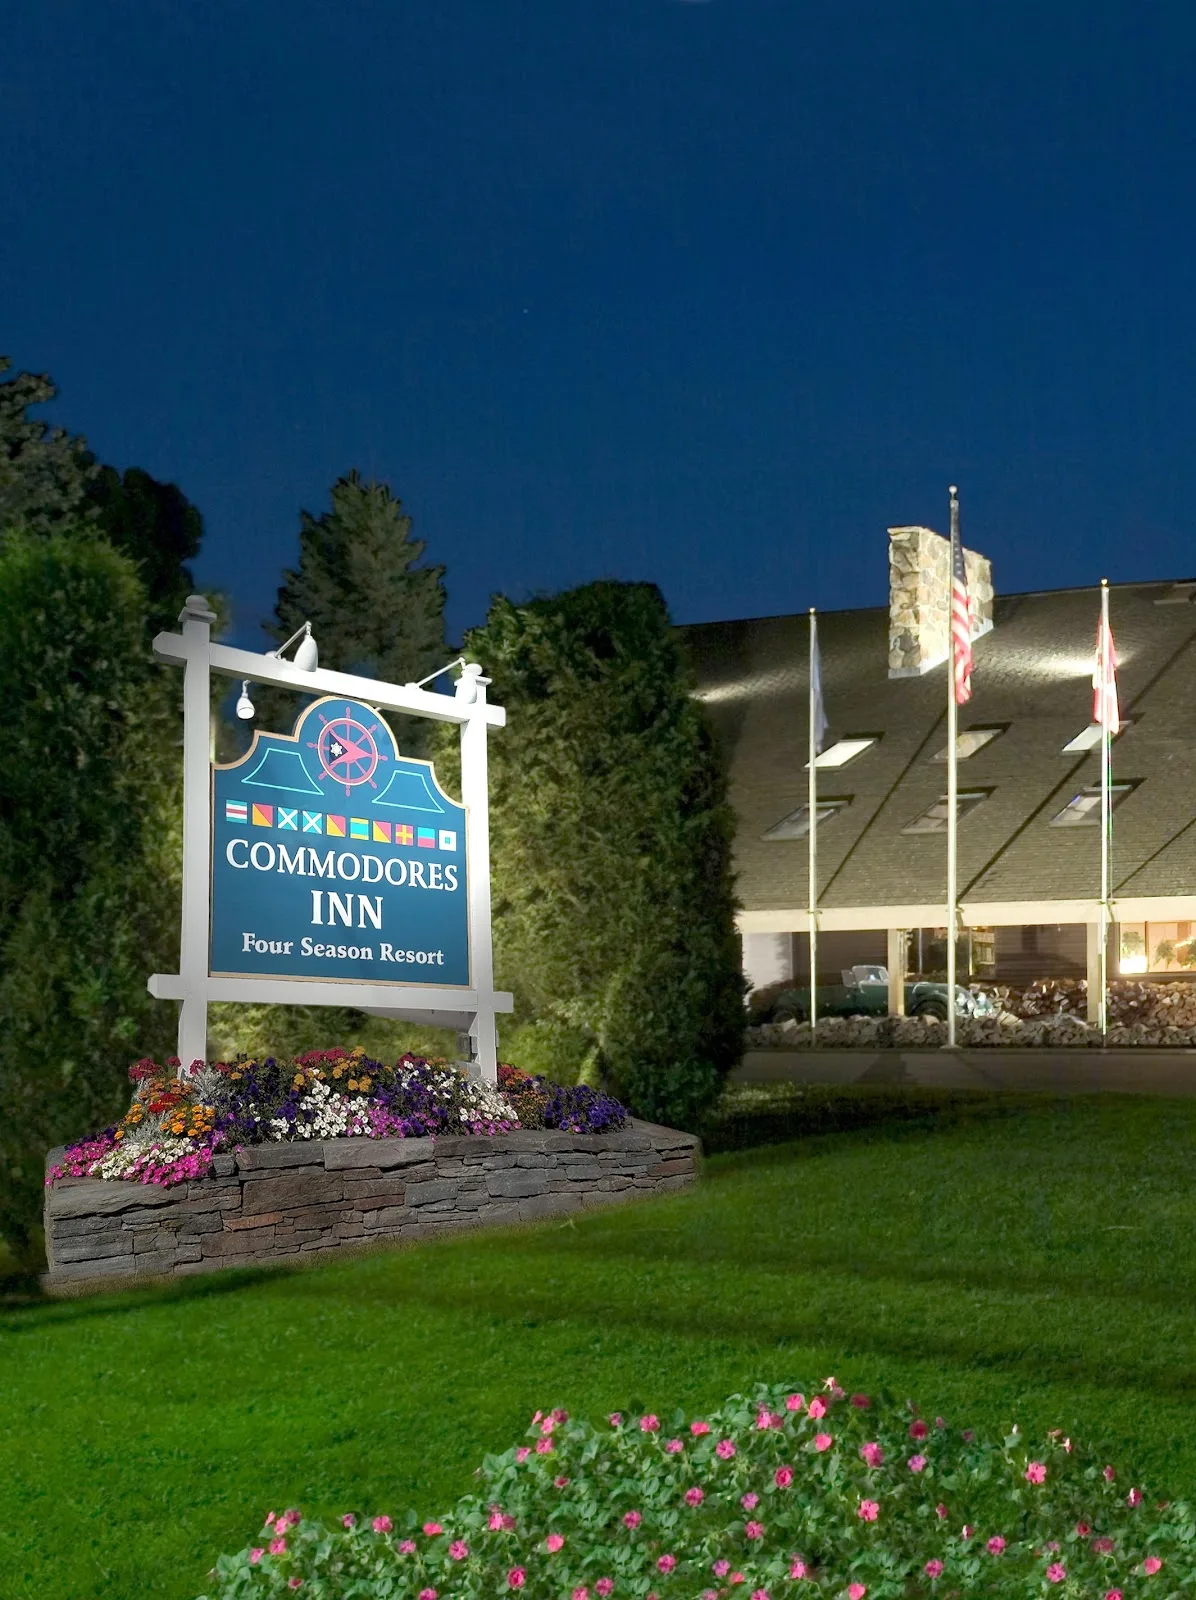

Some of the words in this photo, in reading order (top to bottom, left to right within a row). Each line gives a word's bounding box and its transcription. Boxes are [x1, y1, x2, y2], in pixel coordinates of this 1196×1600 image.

[225, 838, 458, 892] COMMODORES
[310, 889, 384, 930] INN
[241, 932, 294, 956] Four
[300, 936, 374, 961] Season
[380, 943, 445, 966] Resort
